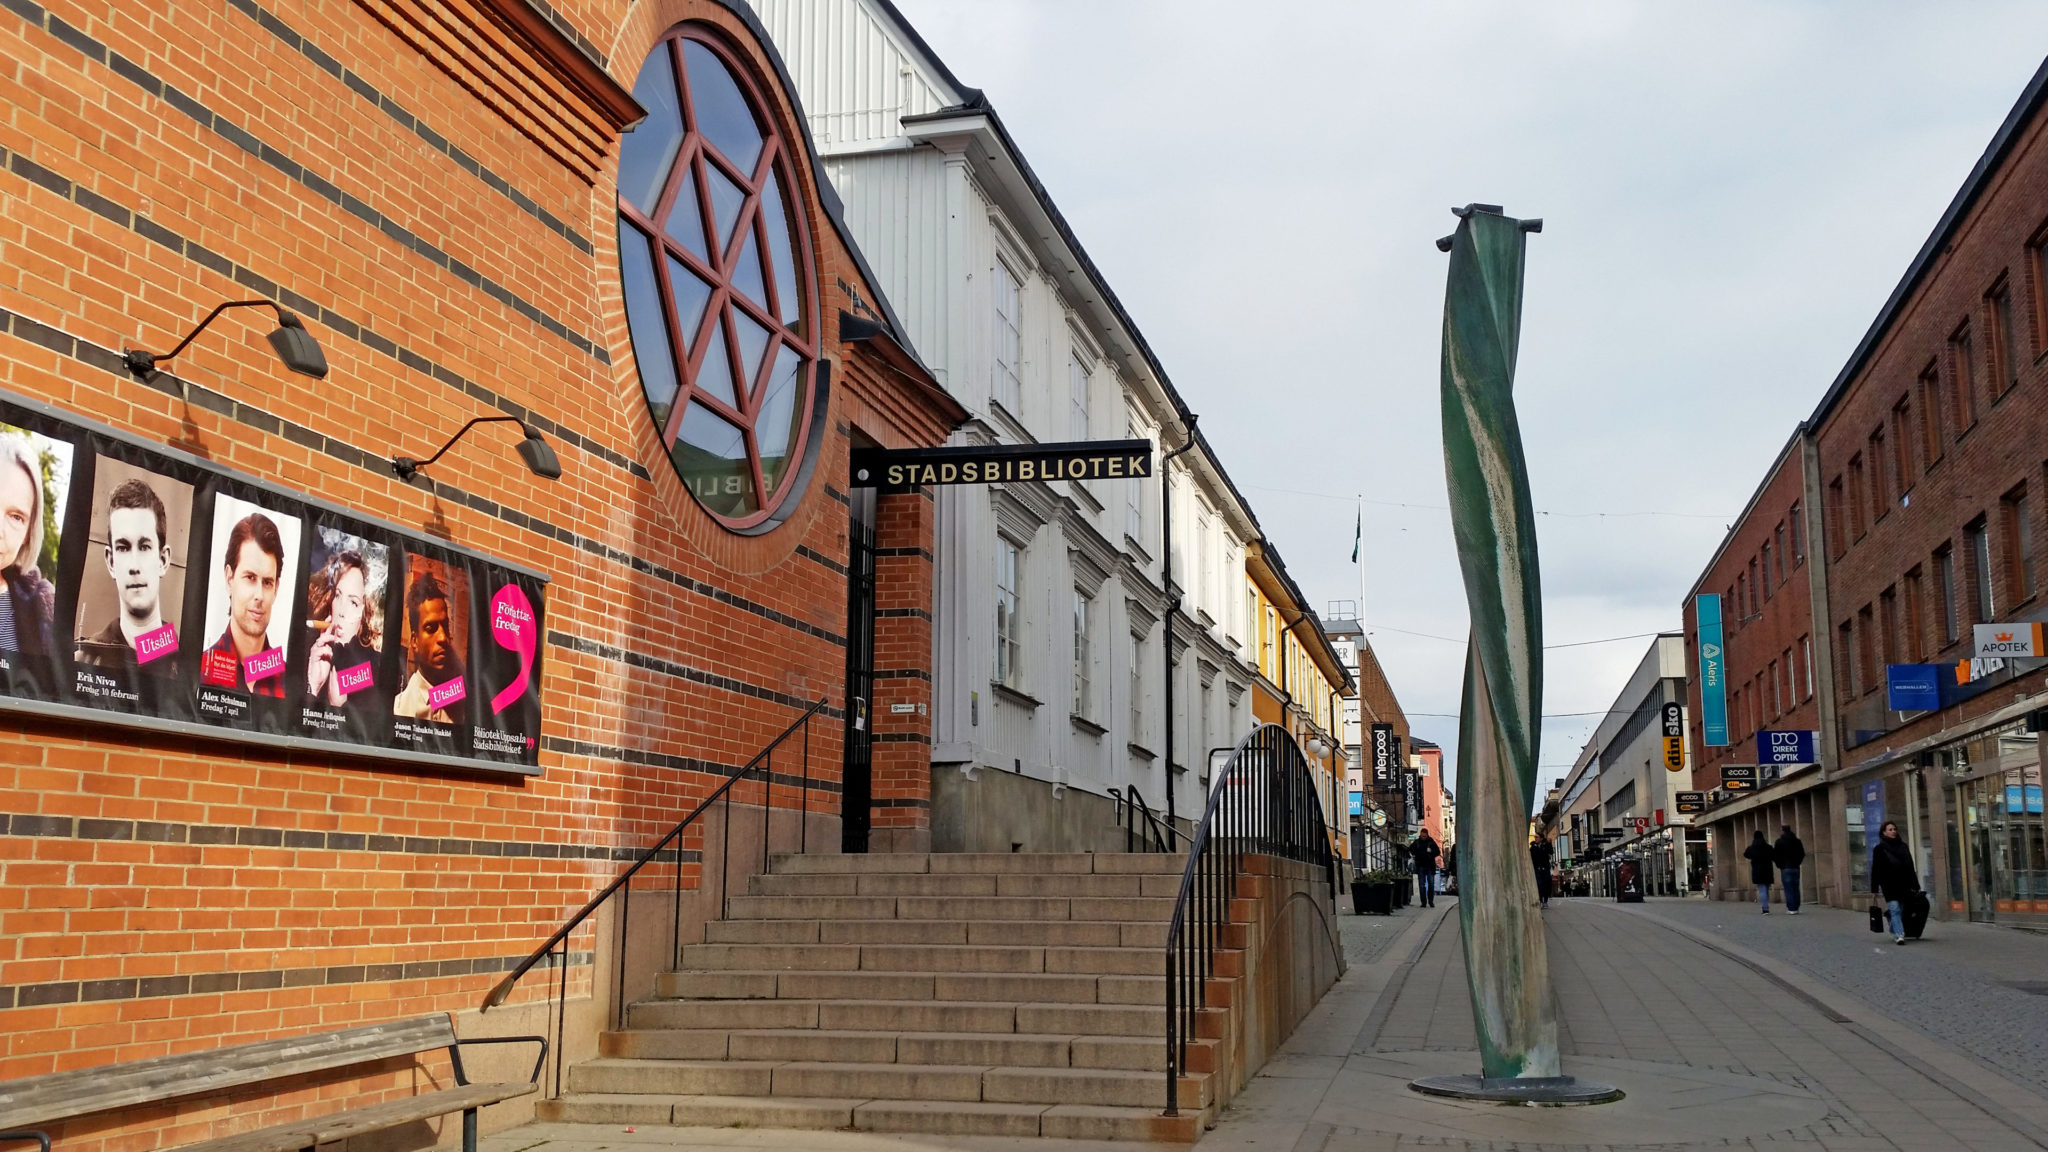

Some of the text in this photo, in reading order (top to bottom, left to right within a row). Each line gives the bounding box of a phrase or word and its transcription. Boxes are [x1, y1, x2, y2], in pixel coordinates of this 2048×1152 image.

[887, 455, 1147, 485] STADSBIBLIOTEK
[141, 629, 174, 654] Utsålt!
[1982, 642, 2029, 653] APOTEK
[248, 652, 282, 675] Utsålt!
[77, 671, 117, 687] Erik Niva
[341, 667, 370, 688] Utsålt!
[1708, 660, 1717, 687] Aleris
[101, 687, 109, 696] 10
[201, 691, 219, 702] Alex
[433, 681, 463, 703] Utsålt!
[201, 701, 224, 714] Fredag
[1374, 729, 1389, 780] interpool
[1772, 745, 1798, 753] DIREKT
[1773, 753, 1799, 761] OPTIK
